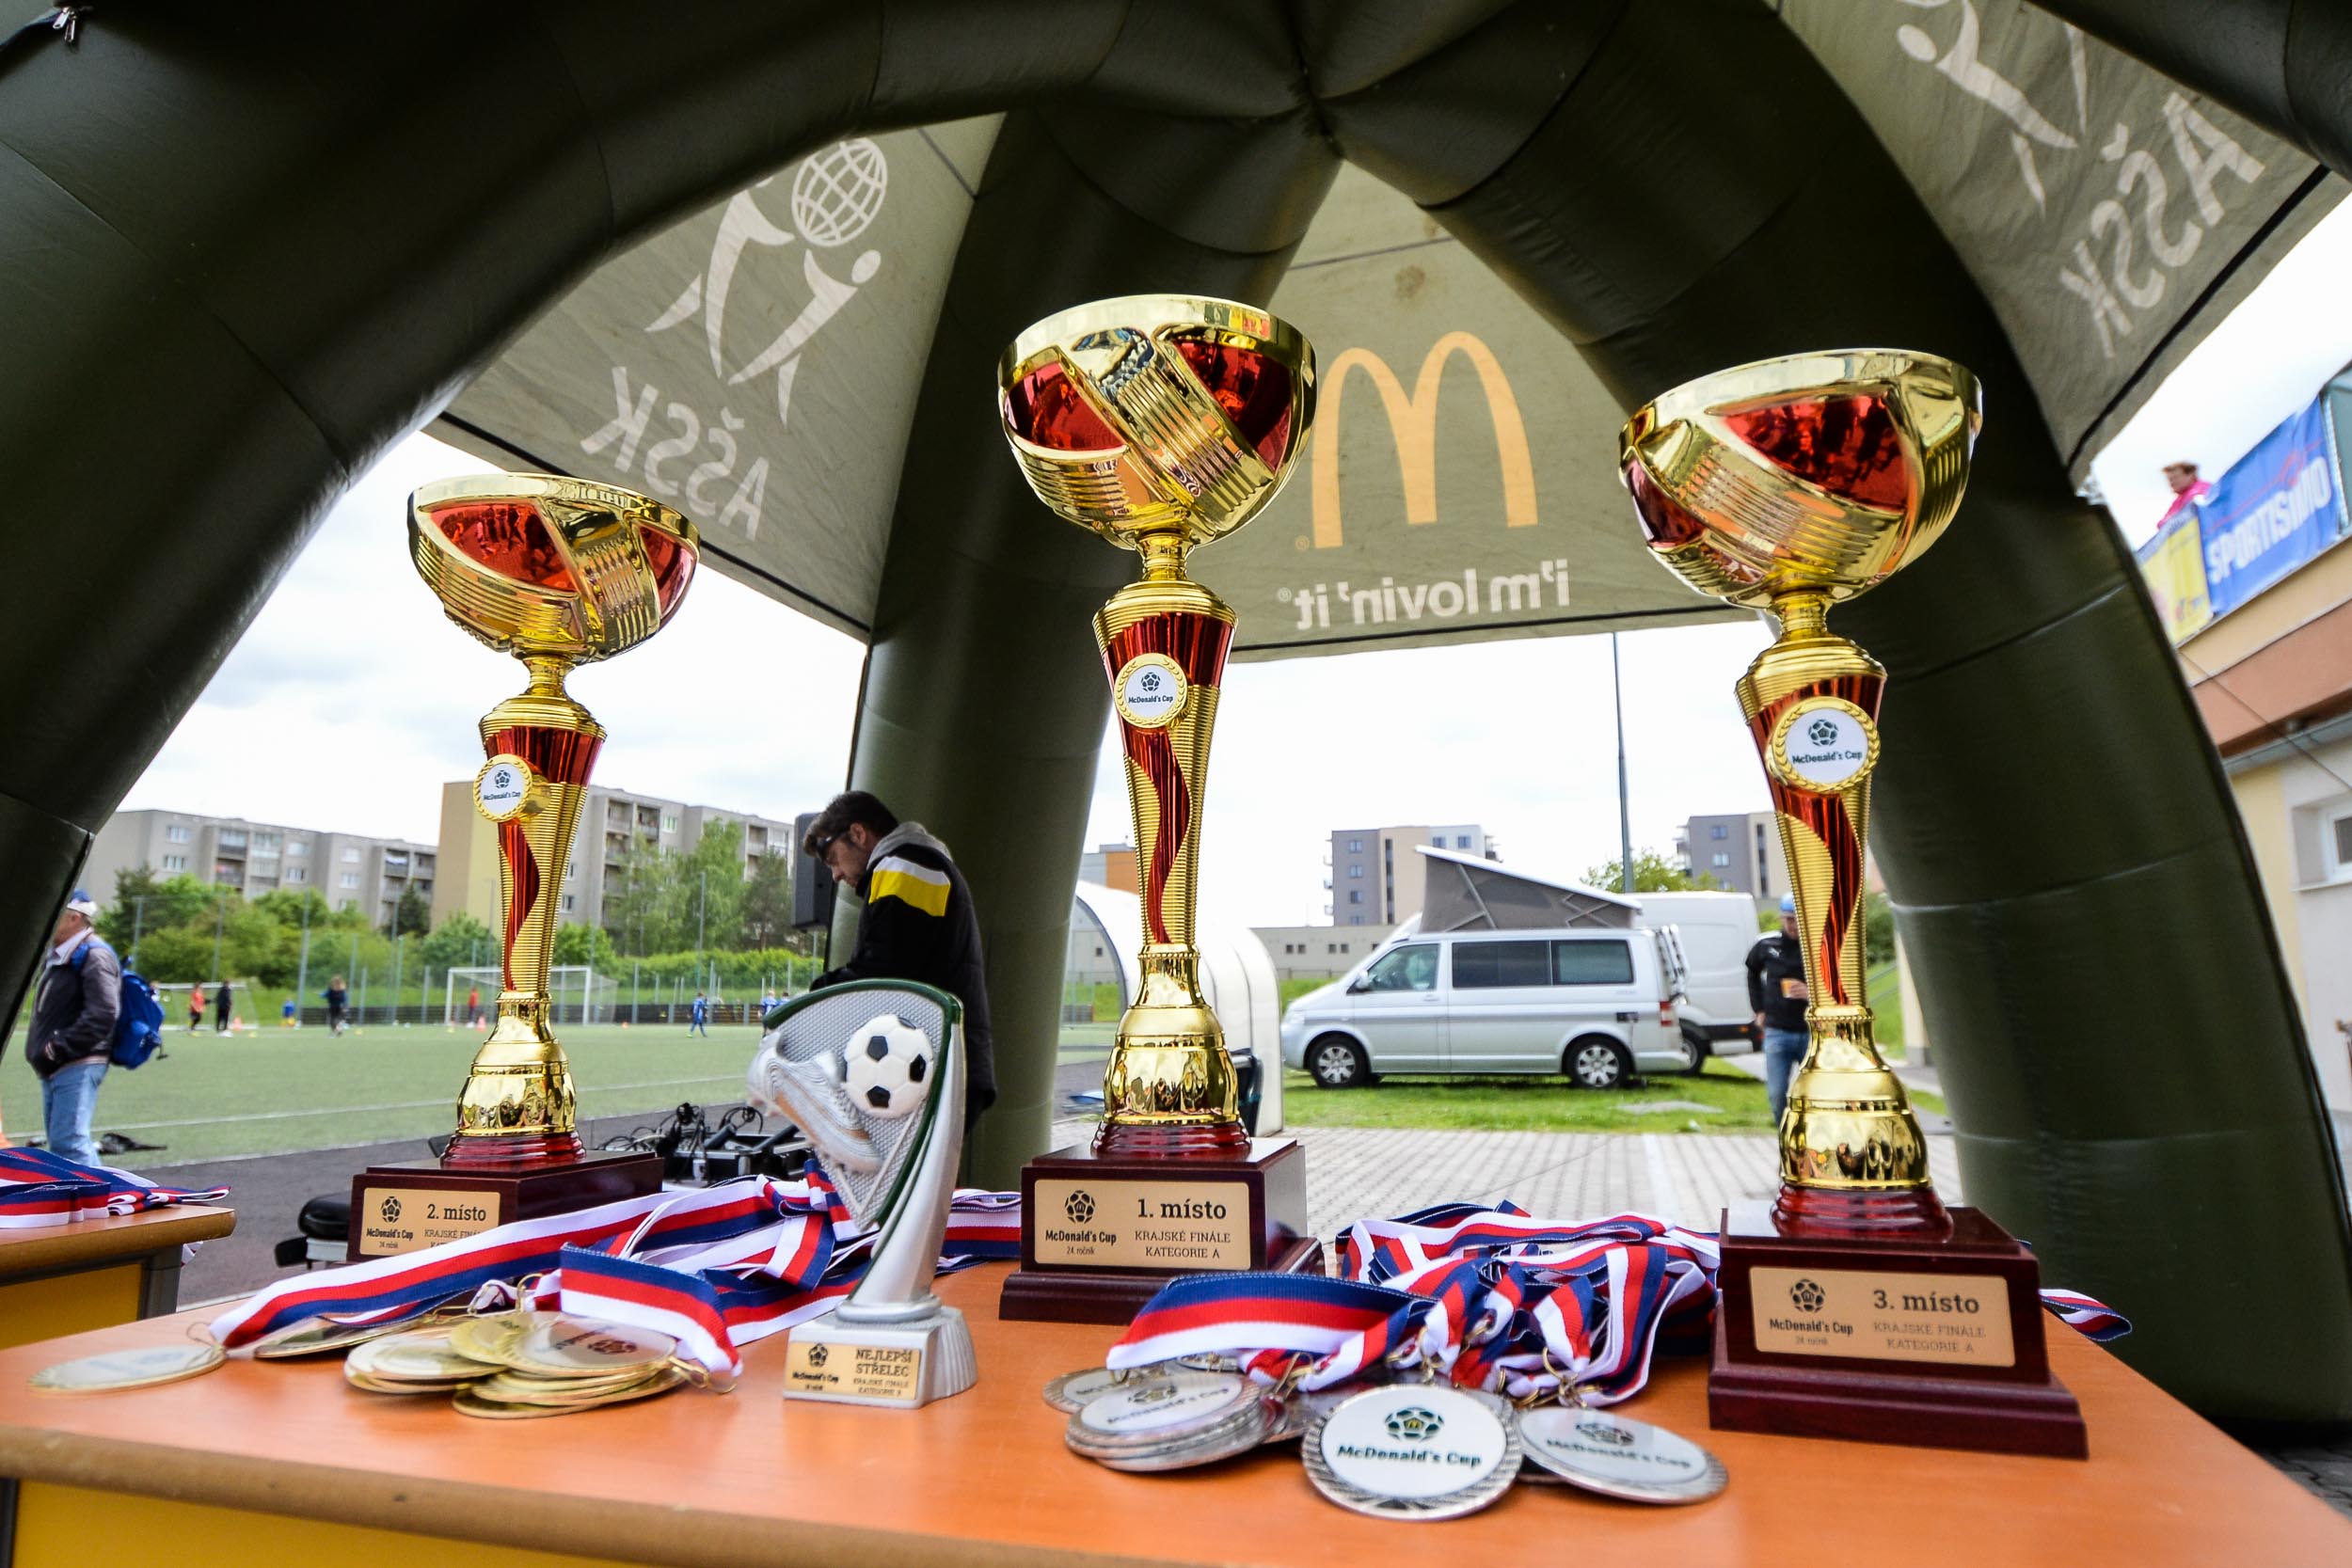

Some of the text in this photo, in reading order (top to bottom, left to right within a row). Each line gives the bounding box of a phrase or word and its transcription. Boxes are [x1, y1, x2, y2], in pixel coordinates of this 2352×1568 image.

[1791, 751, 1863, 764] McDonald's Cup
[426, 1204, 486, 1222] 2. místo
[1137, 1198, 1227, 1219] 1. místo
[366, 1227, 414, 1241] McDonald's Cup
[424, 1228, 458, 1239] KRAJSKÉ
[1045, 1230, 1117, 1245] McDonald's Cup
[1135, 1230, 1232, 1243] KRAJSKÉ FINÁLE
[1145, 1247, 1220, 1259] KATEGORIE A
[1873, 1290, 1979, 1314] 3. místo
[1770, 1319, 1853, 1337] McDonald's Cup
[855, 1349, 913, 1363] NEJLEPŠÍ
[855, 1363, 909, 1377] STŘELEC
[1337, 1445, 1481, 1469] McDonald's Cup
